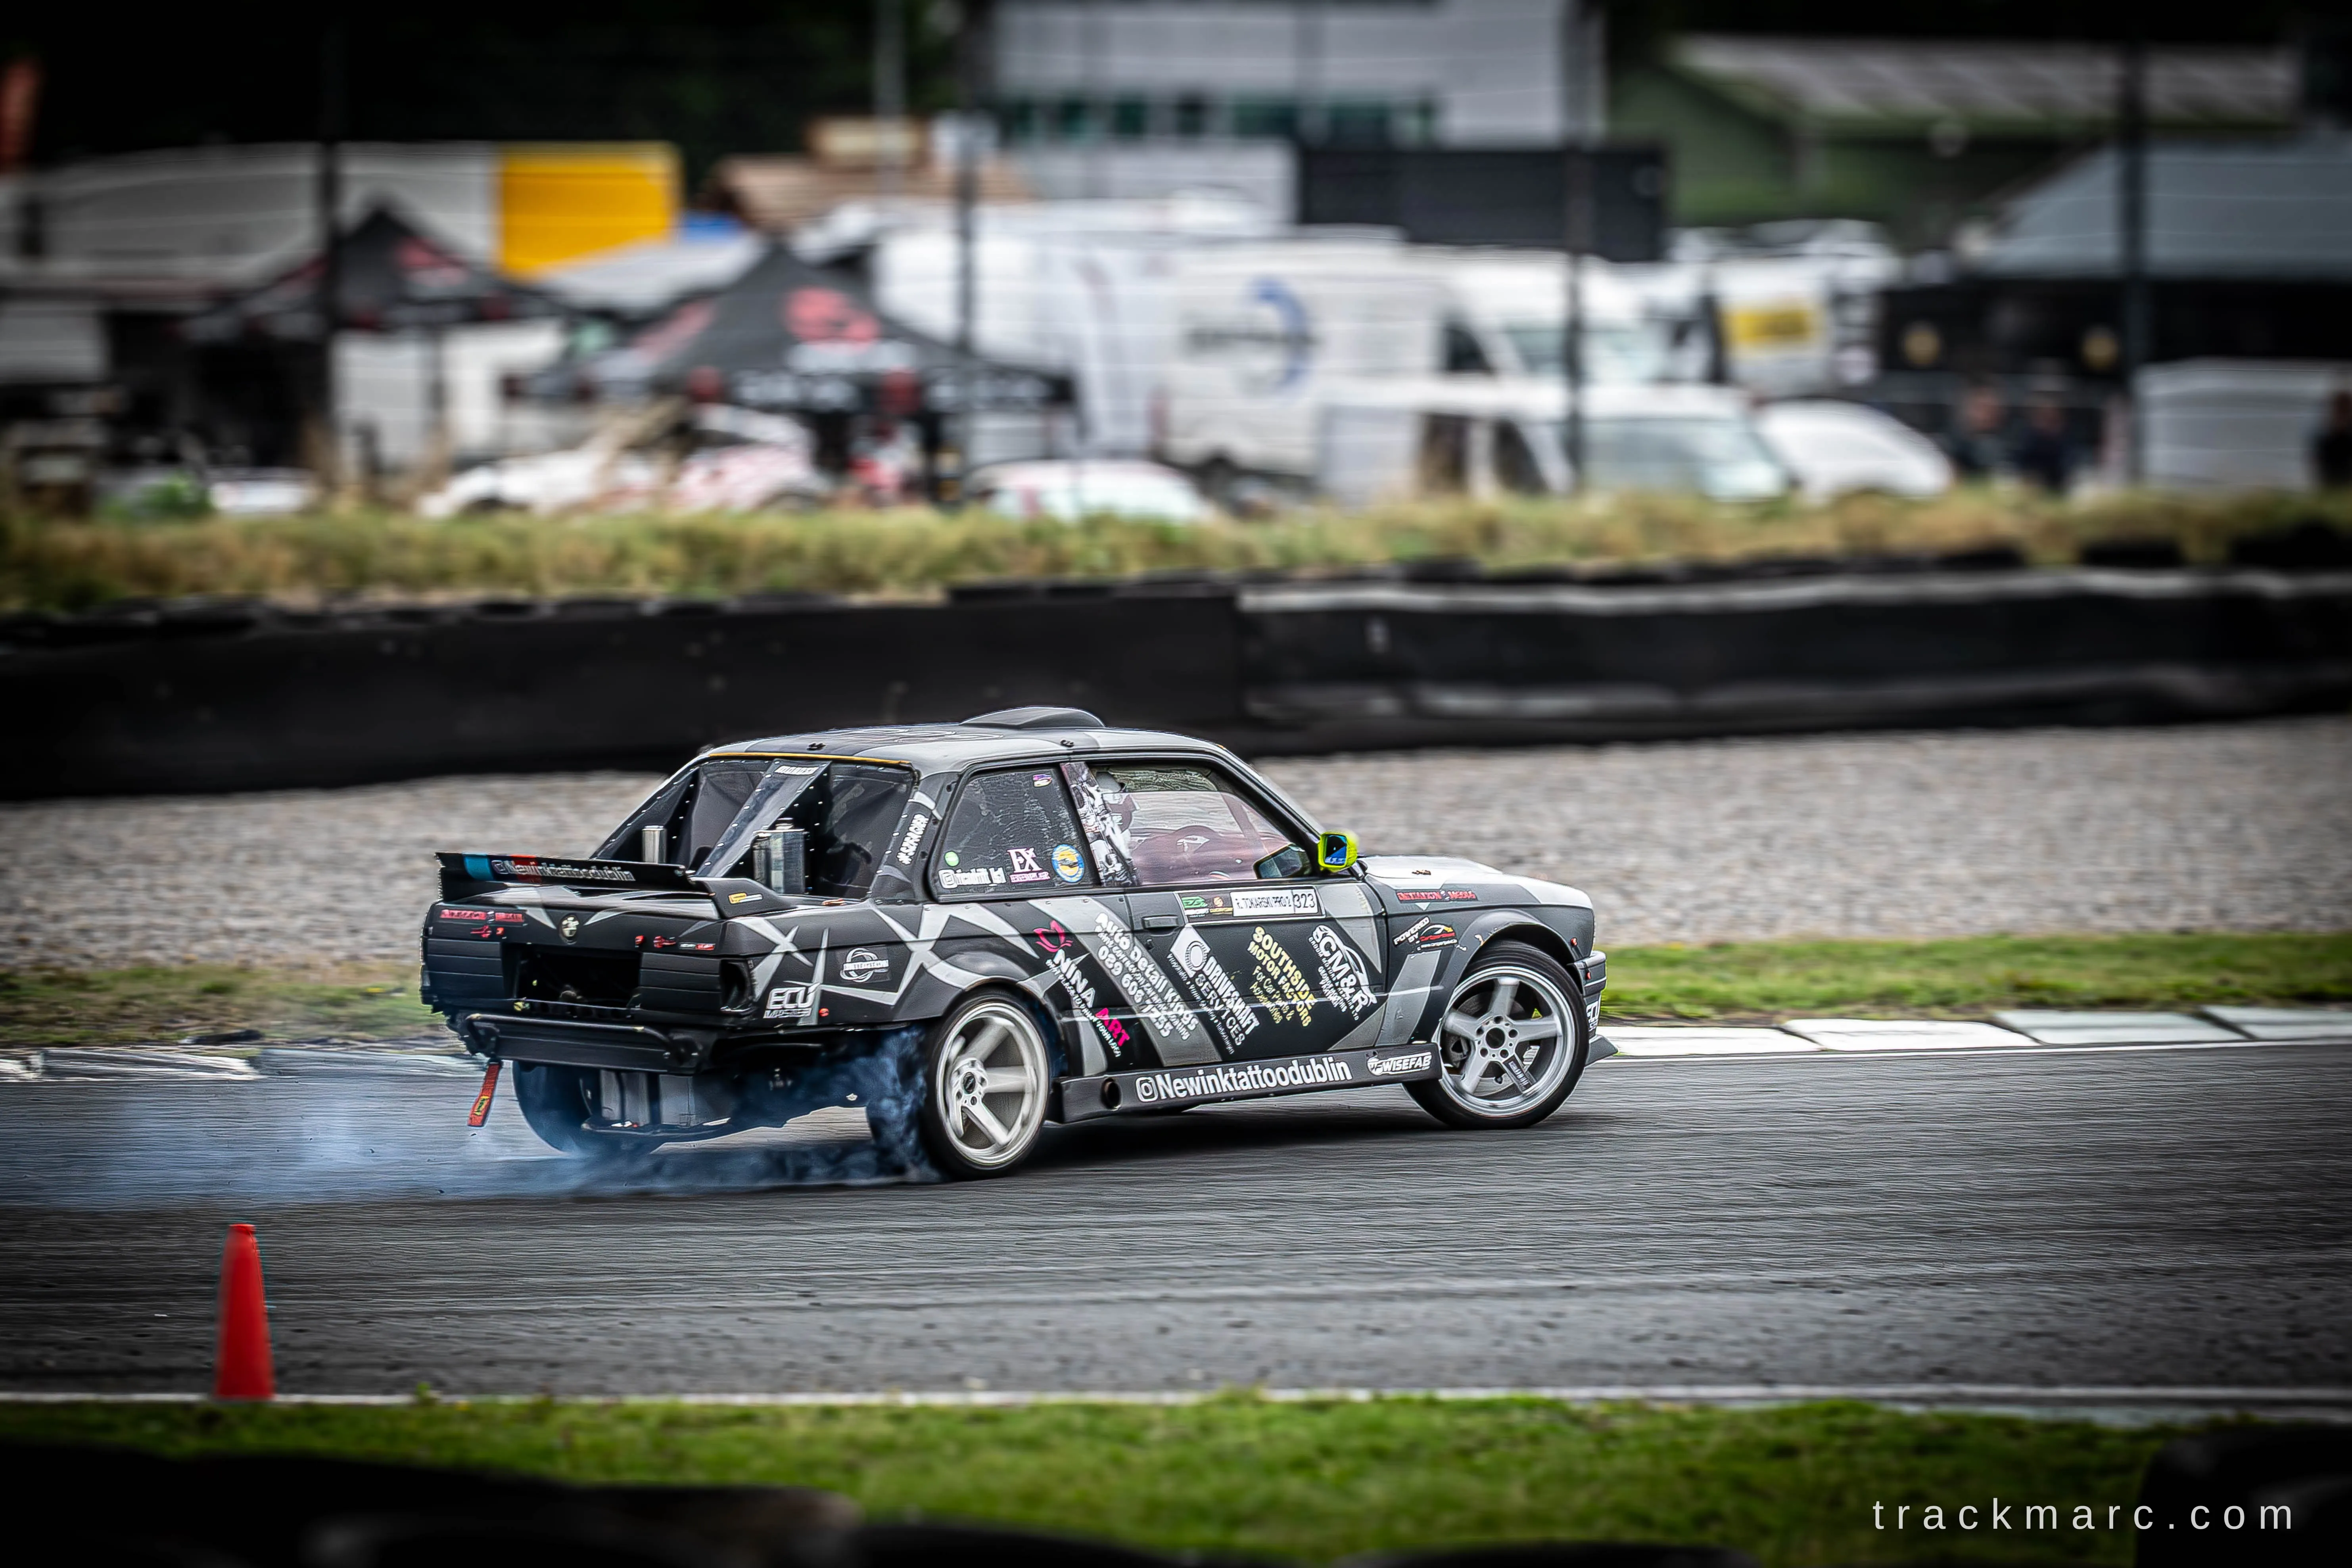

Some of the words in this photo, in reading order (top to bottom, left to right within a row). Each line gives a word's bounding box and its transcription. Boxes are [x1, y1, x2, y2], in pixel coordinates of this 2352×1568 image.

[1293, 893, 1315, 909] 323
[1394, 917, 1429, 946] POWERED
[1408, 933, 1419, 944] BY
[1130, 946, 1168, 993] Detail
[1247, 941, 1281, 980] MOTOR
[1278, 975, 1312, 1027] FACTORS
[1253, 926, 1318, 1010] SOUTHSIDE
[766, 982, 821, 1010] ECU
[1053, 949, 1095, 1008] NINA
[1095, 1008, 1130, 1046] ART
[1195, 974, 1245, 1046] SERVICES
[1202, 956, 1260, 1035] DRIVESHAFT
[1383, 1056, 1431, 1072] WISEFAB
